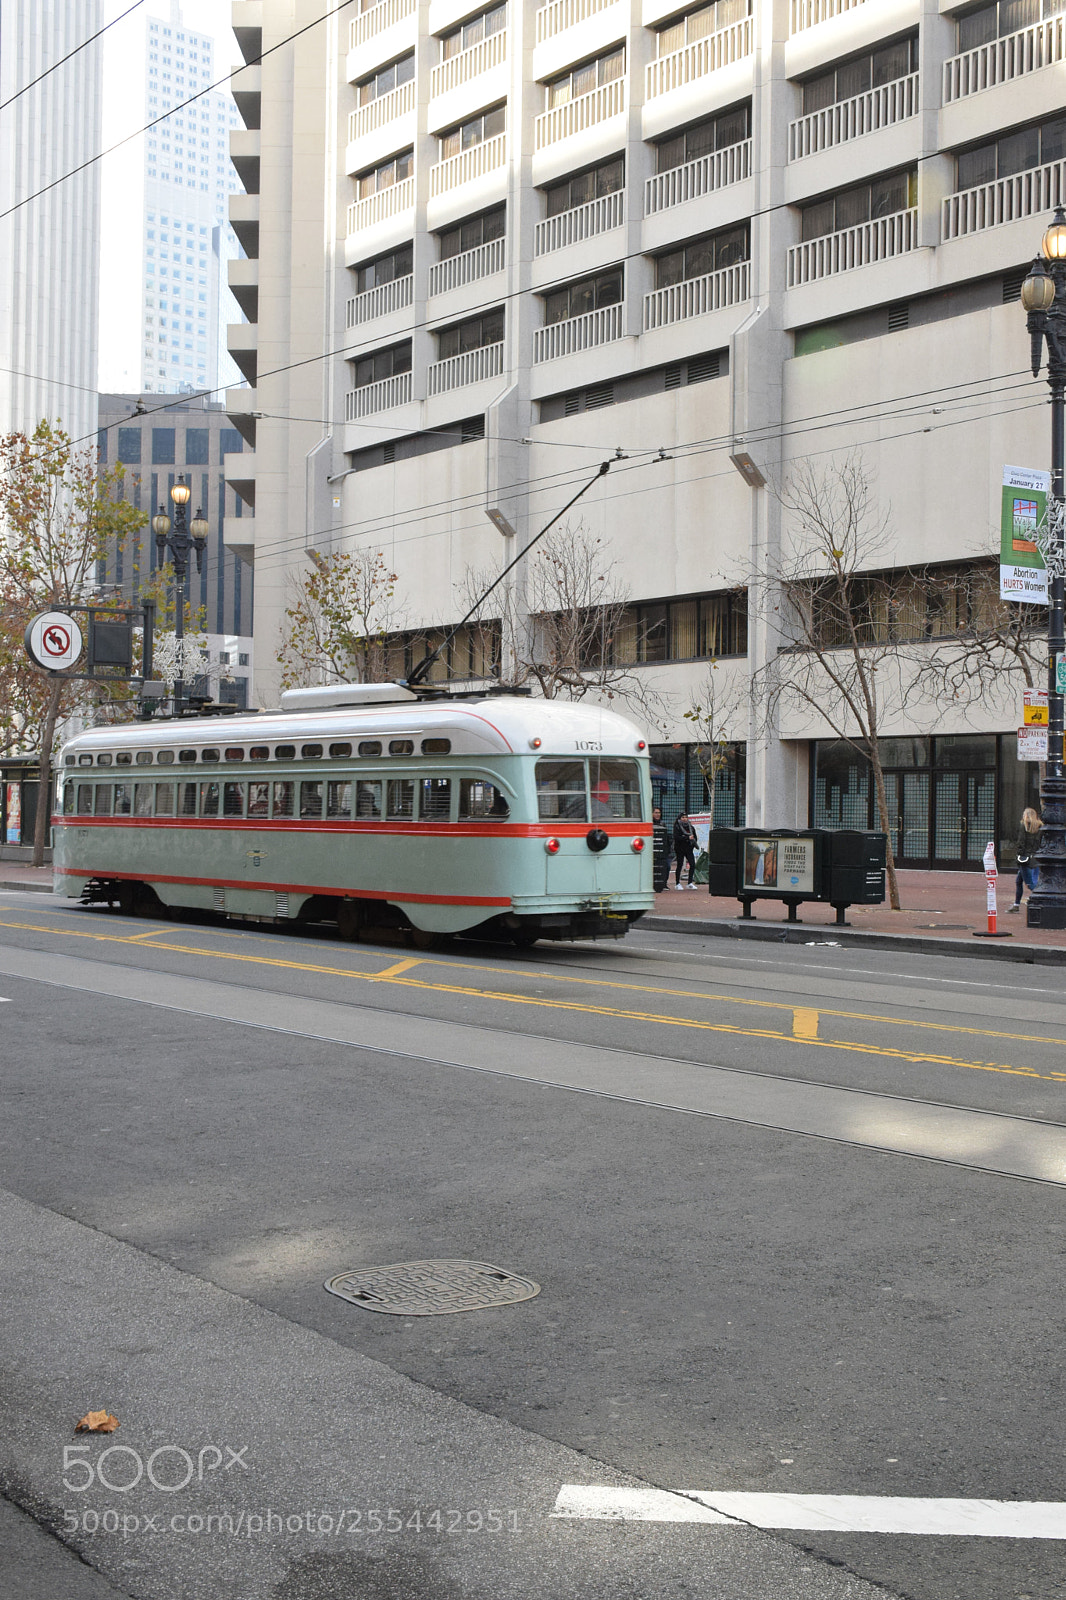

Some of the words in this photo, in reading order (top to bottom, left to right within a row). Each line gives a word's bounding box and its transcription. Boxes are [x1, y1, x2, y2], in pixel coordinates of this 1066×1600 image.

[1009, 477, 1034, 489] January
[1035, 481, 1044, 489] 27
[1014, 516, 1033, 526] Walk
[1013, 567, 1039, 580] Abortion
[1003, 577, 1024, 590] HURTS
[1023, 580, 1046, 593] Women
[1028, 730, 1047, 738] PARKING
[574, 740, 603, 751] 1073
[784, 845, 806, 854] FARMERS
